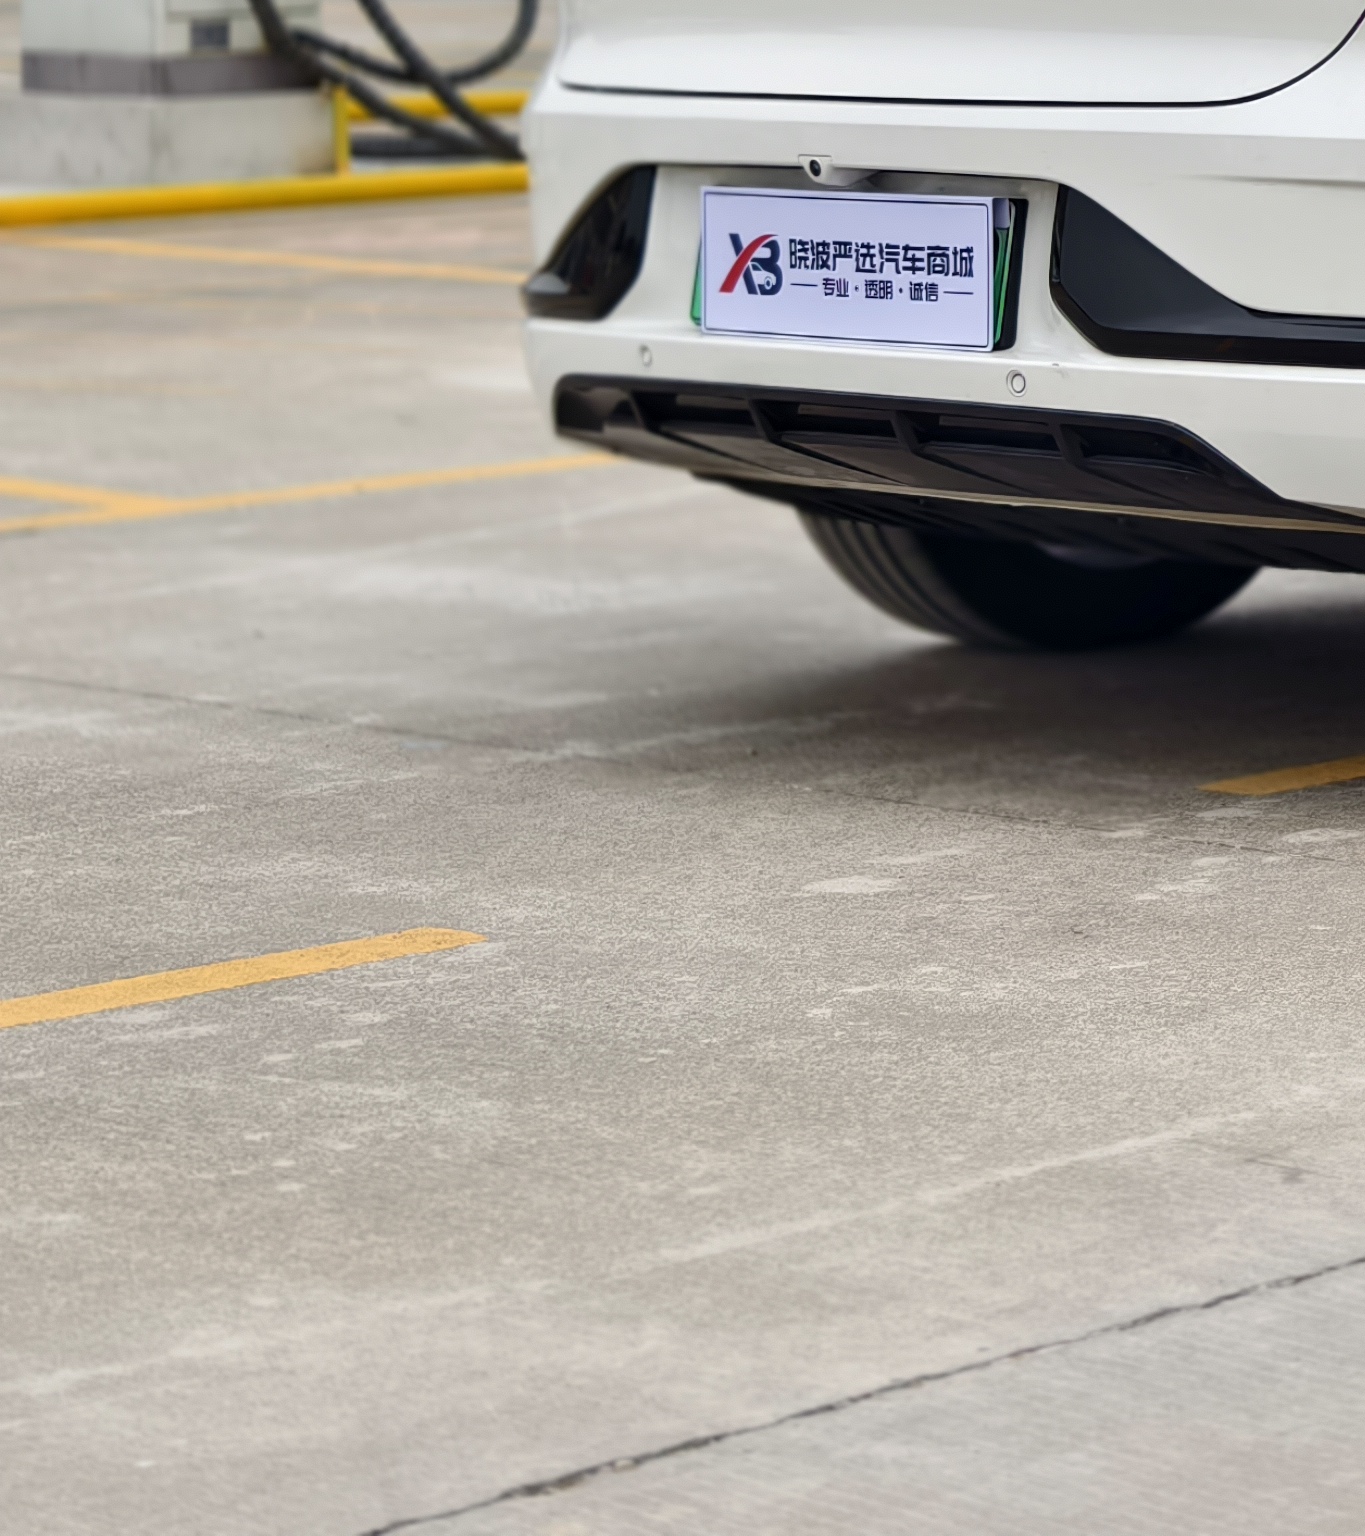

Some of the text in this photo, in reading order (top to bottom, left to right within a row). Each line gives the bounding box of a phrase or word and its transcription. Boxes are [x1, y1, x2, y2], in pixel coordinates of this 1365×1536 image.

[788, 238, 975, 278] 晓波严选汽车商城
